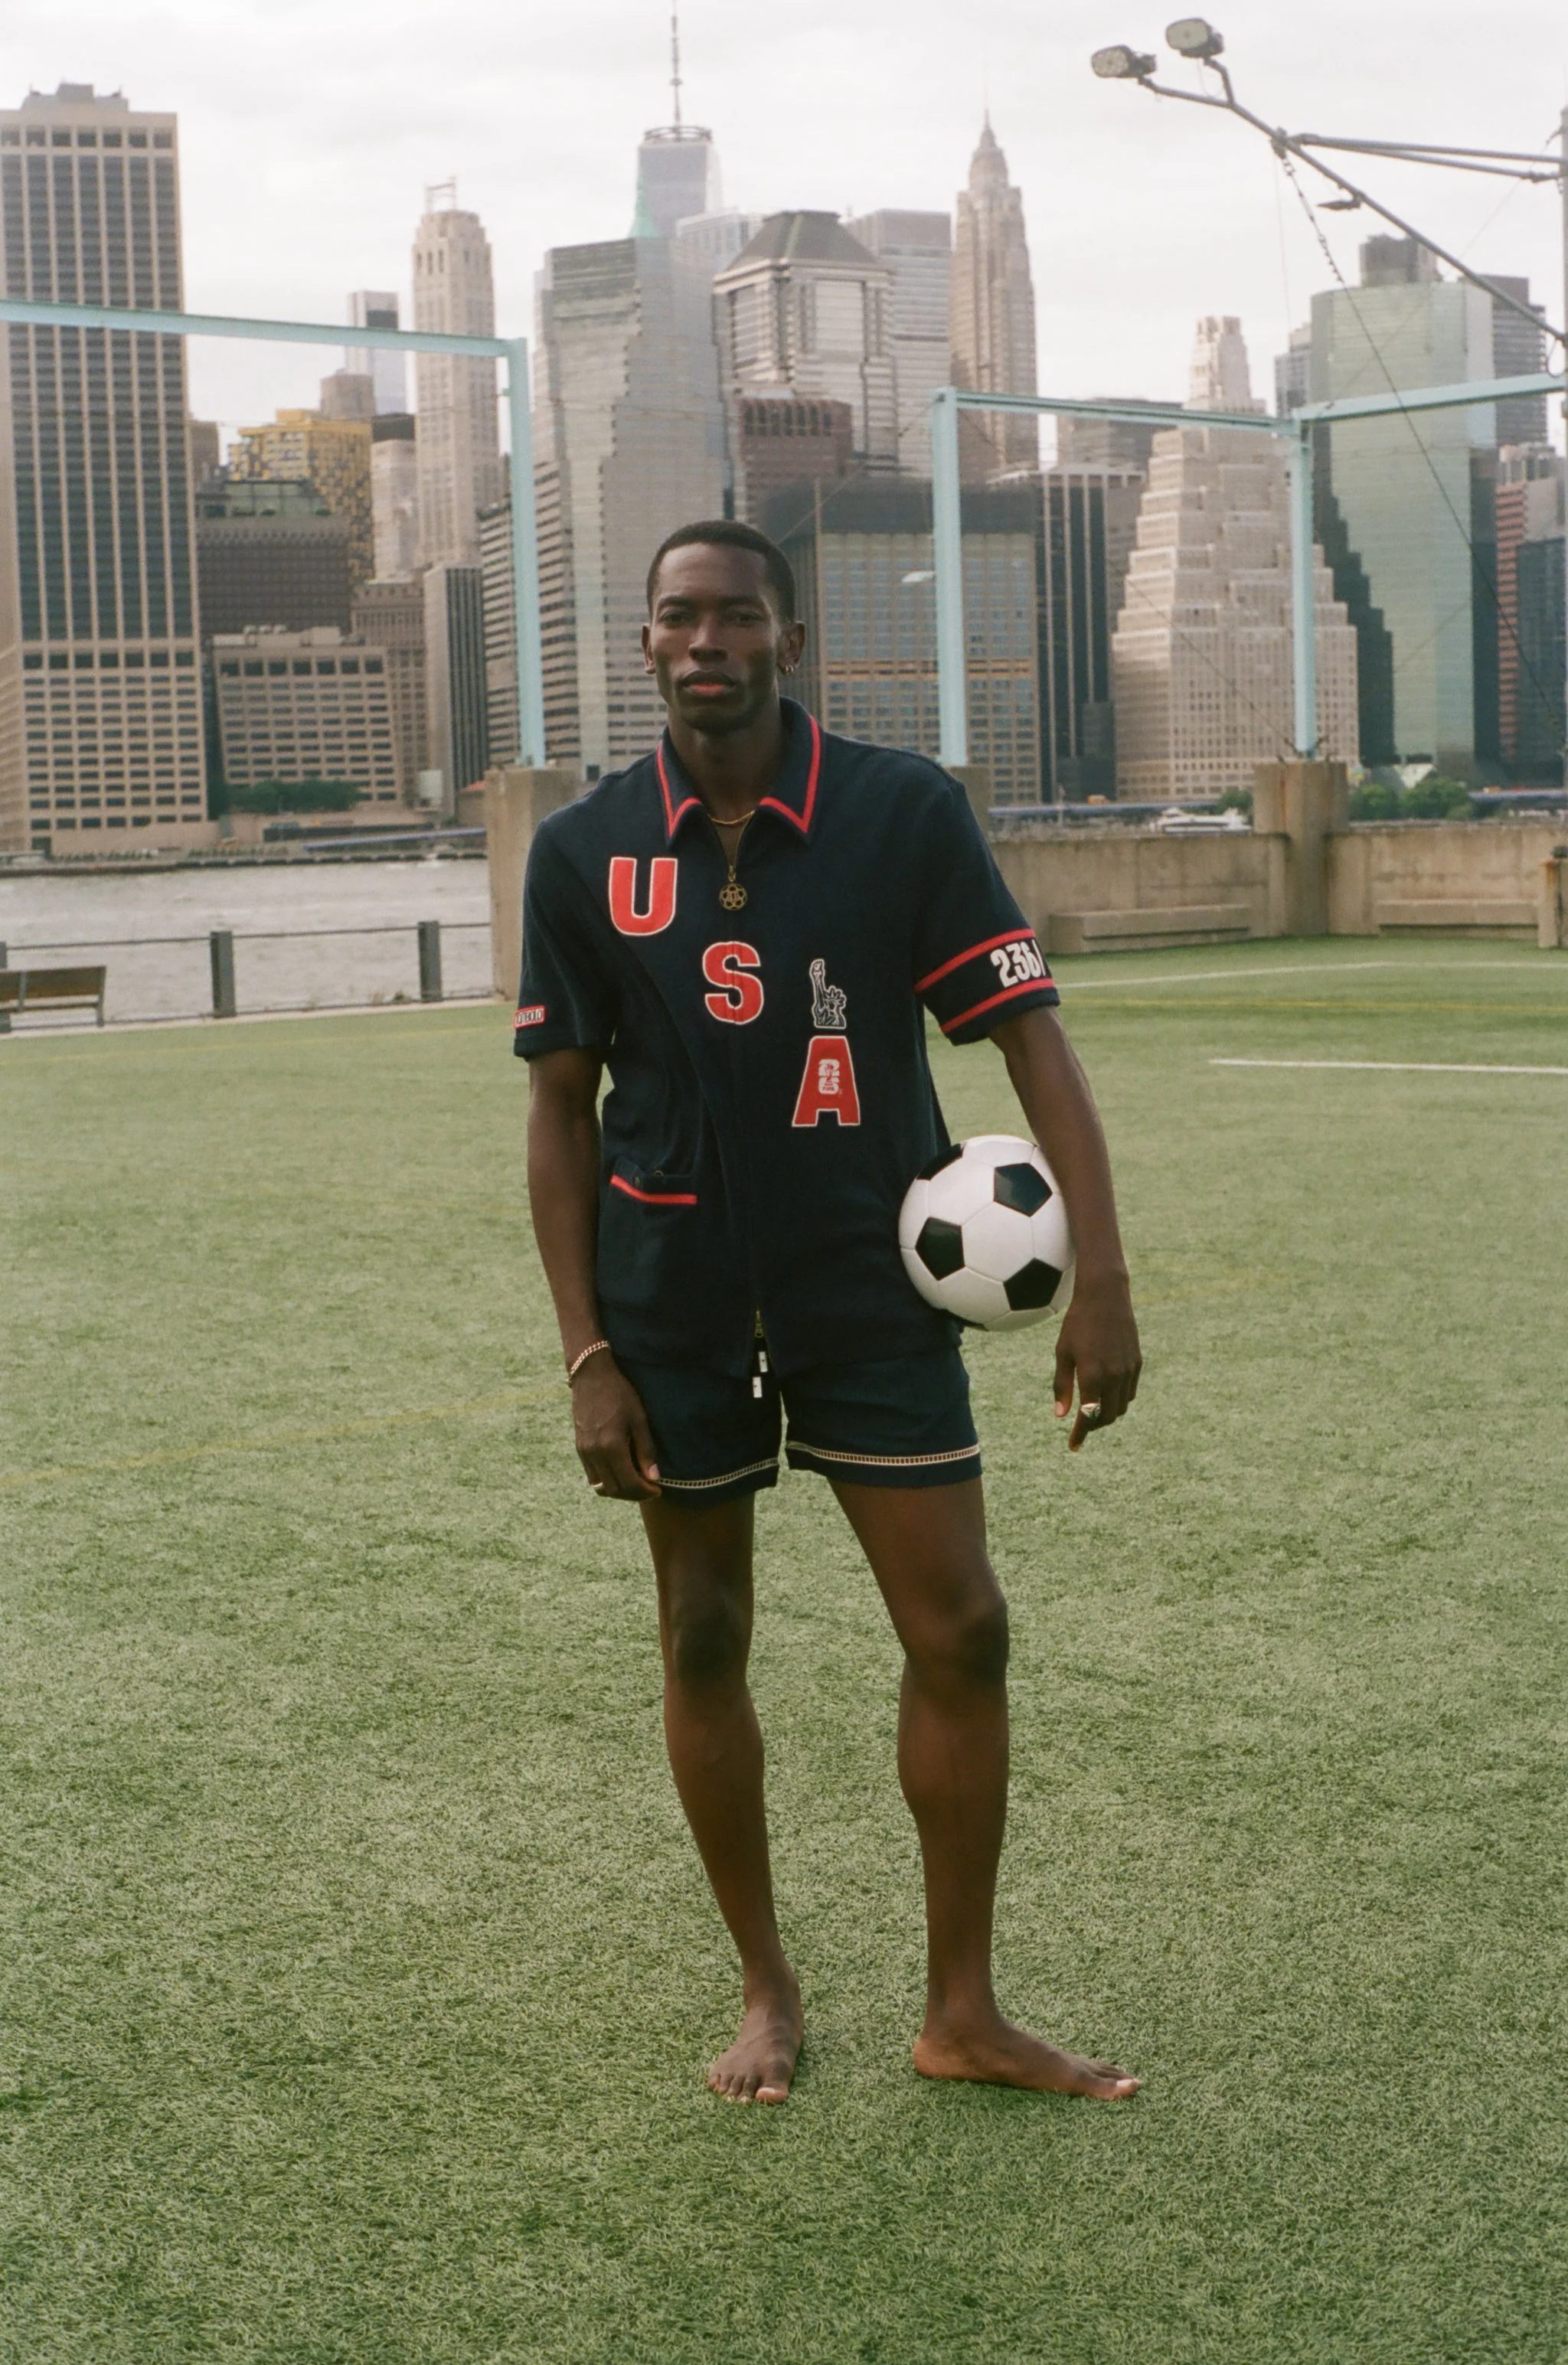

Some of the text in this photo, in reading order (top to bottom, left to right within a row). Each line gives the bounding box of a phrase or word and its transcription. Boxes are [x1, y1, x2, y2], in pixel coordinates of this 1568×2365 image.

[609, 857, 861, 1127] U S A
